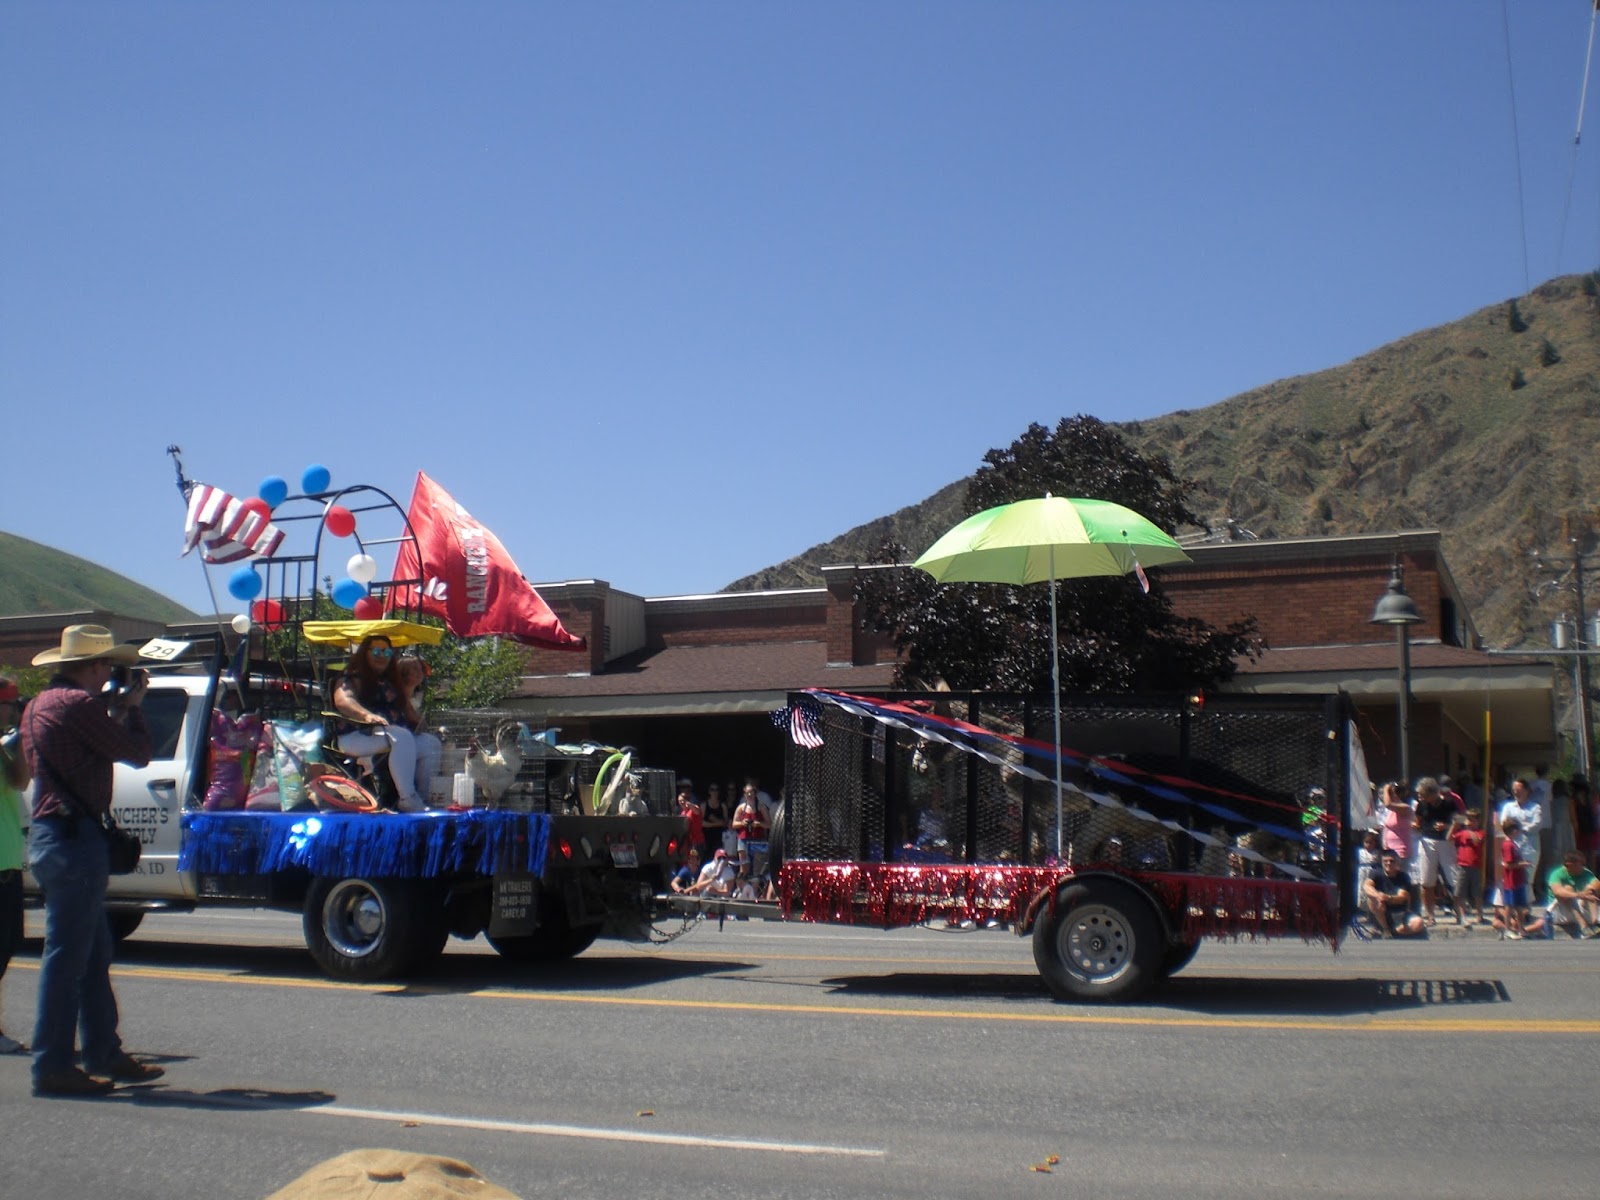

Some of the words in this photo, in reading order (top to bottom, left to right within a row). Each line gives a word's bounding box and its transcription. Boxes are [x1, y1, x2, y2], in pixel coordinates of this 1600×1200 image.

[143, 645, 176, 658] 29
[112, 806, 169, 825] NCHER'S
[149, 862, 165, 875] ID
